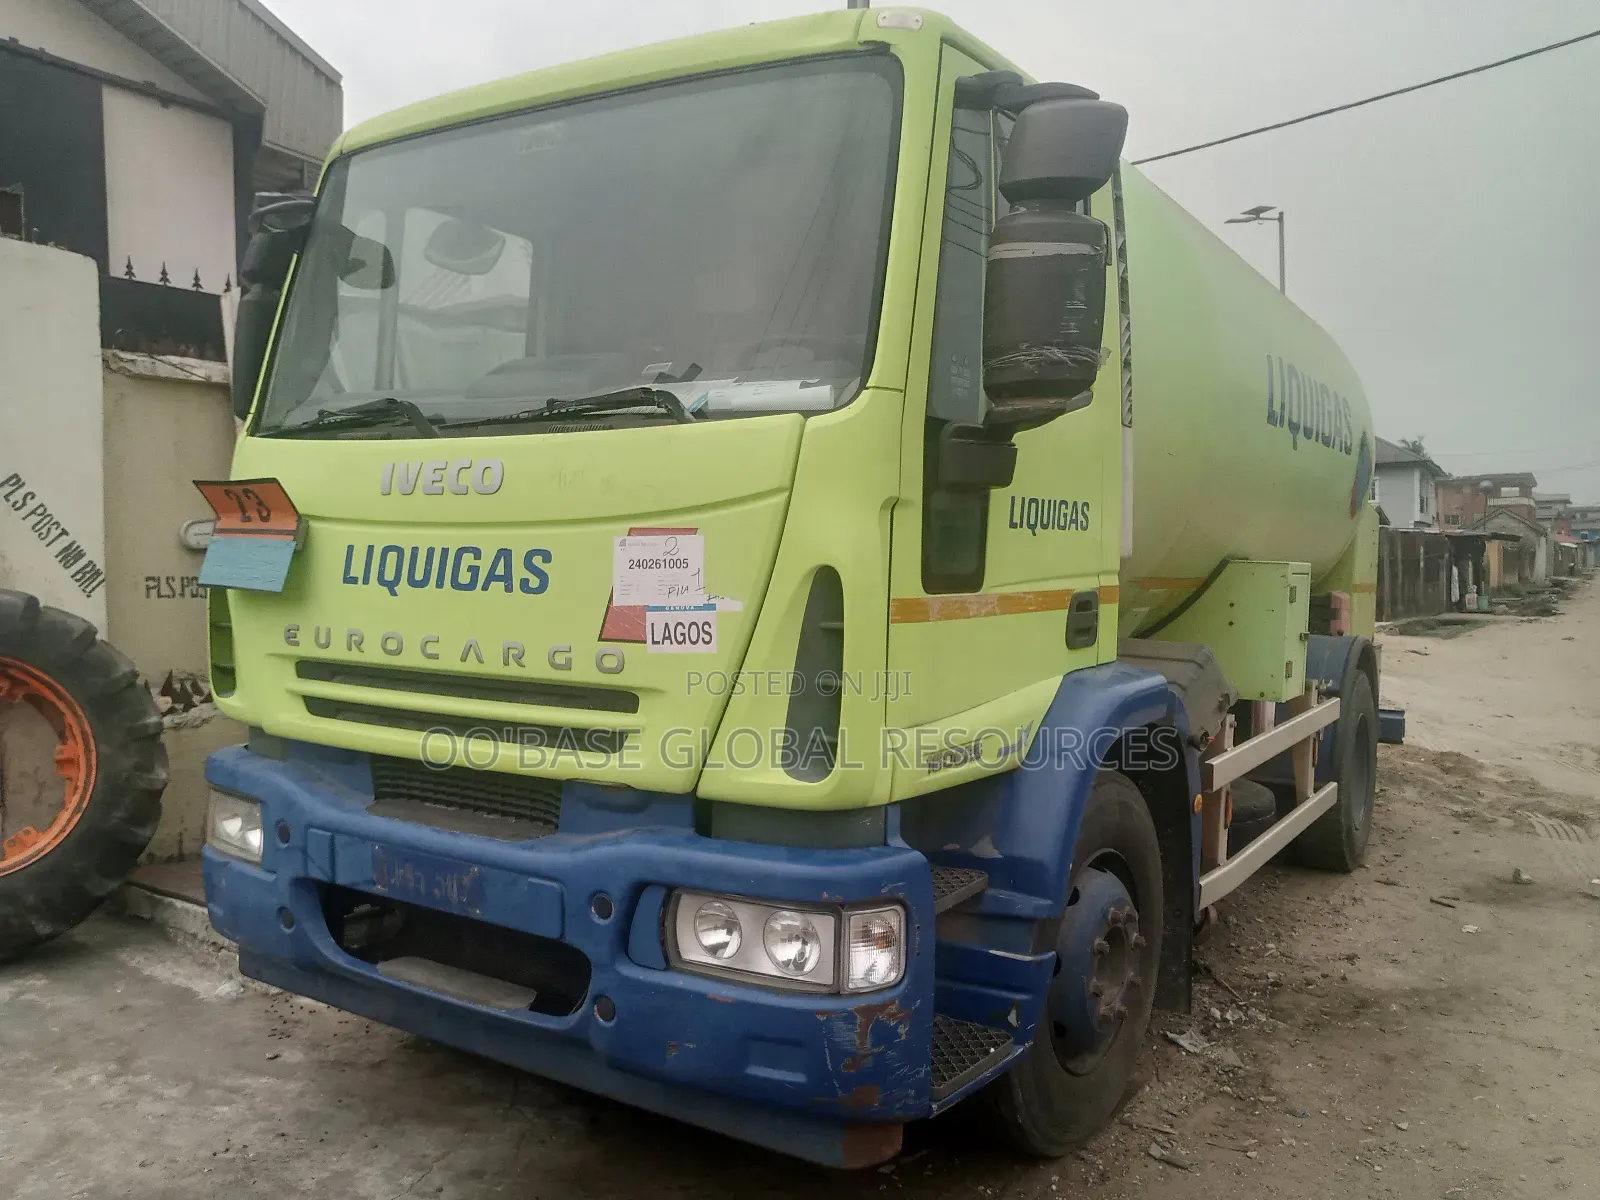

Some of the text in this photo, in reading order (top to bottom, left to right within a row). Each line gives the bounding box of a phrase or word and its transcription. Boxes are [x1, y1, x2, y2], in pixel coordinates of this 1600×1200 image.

[1266, 354, 1353, 456] LIQUIGAS
[380, 459, 504, 496] IVECO
[0, 472, 36, 512] PLS
[21, 502, 70, 548] POST
[1008, 495, 1090, 536] LIQUIGAS
[628, 558, 689, 570] 240261005
[662, 536, 680, 557] 2
[342, 544, 553, 596] LIQUIGAS
[284, 623, 626, 675] EUROCARGO
[650, 621, 713, 646] LAGOS
